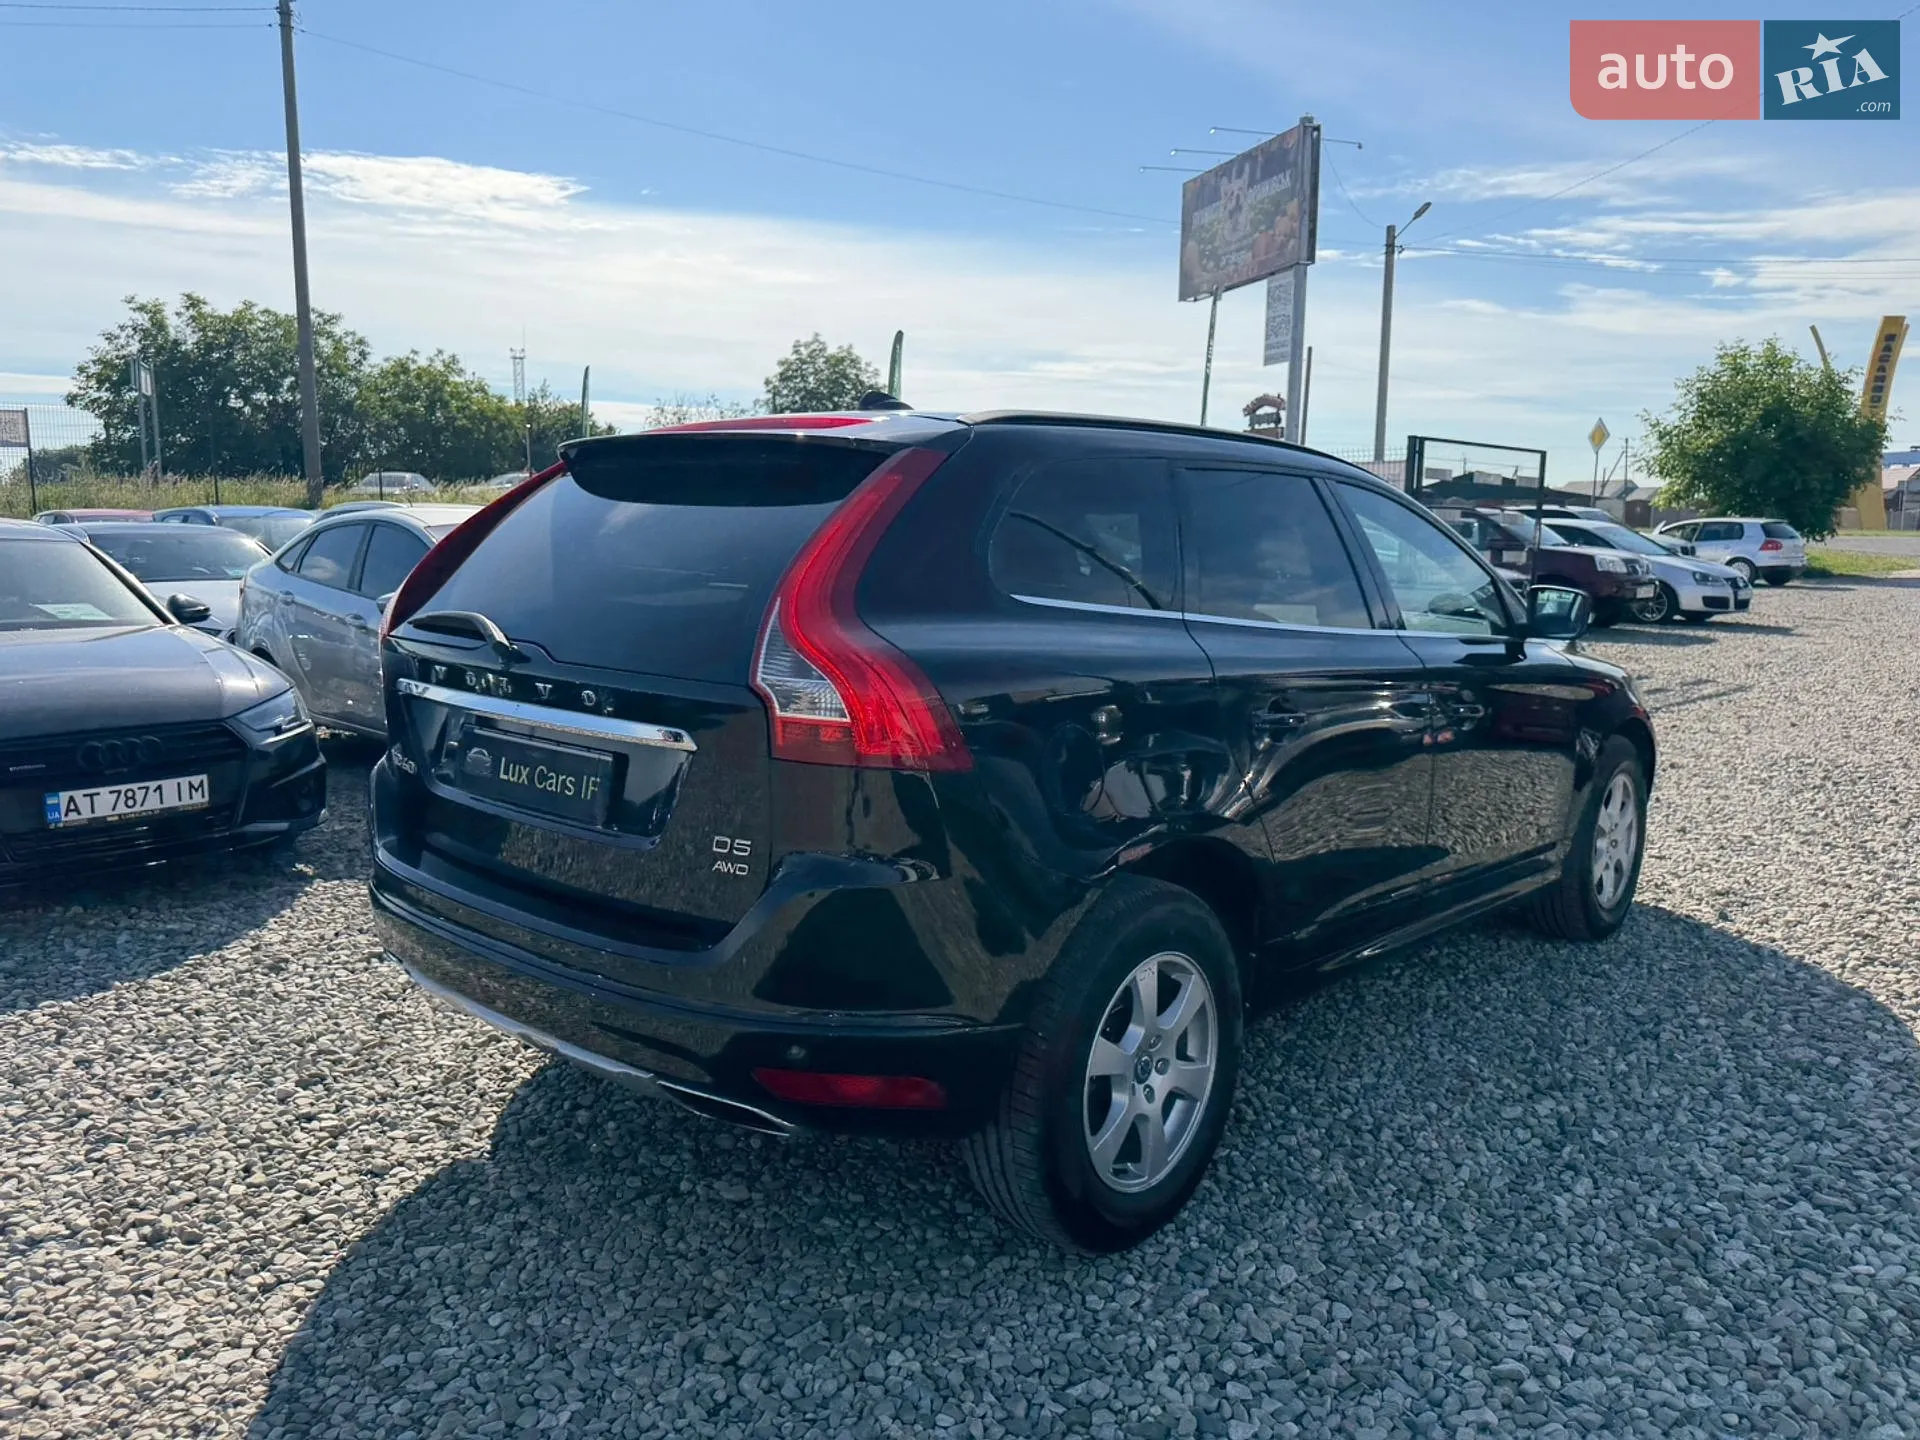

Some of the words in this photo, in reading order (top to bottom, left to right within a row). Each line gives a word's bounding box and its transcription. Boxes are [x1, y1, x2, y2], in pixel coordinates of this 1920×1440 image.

[499, 756, 531, 785] Lux
[534, 765, 576, 796] Cars
[581, 774, 601, 800] IF
[64, 792, 101, 817] AT
[109, 784, 165, 812] 7871
[177, 779, 206, 802] IM
[712, 835, 752, 856] D5
[711, 860, 749, 876] AWD
